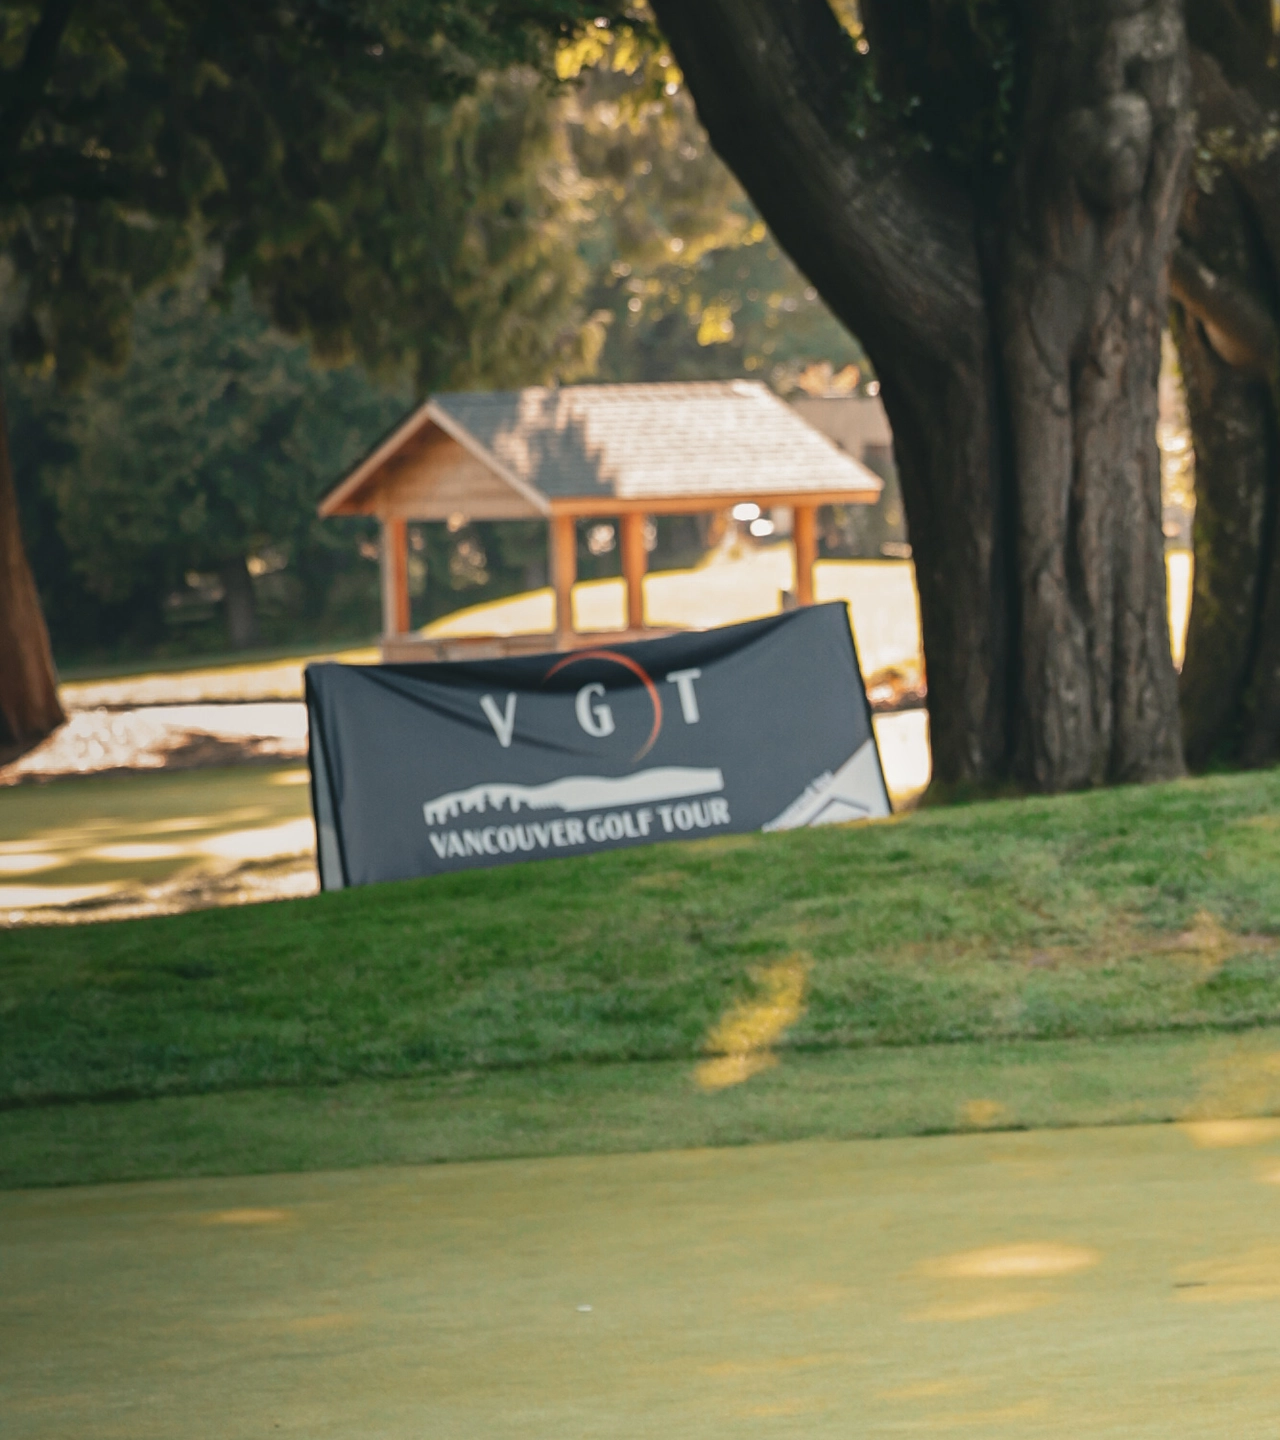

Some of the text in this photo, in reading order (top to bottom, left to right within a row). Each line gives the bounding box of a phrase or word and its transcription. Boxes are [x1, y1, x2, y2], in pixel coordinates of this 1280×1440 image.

[428, 817, 586, 859] VANCOUVER
[586, 808, 655, 842] GOLF
[656, 797, 731, 833] TOUR
